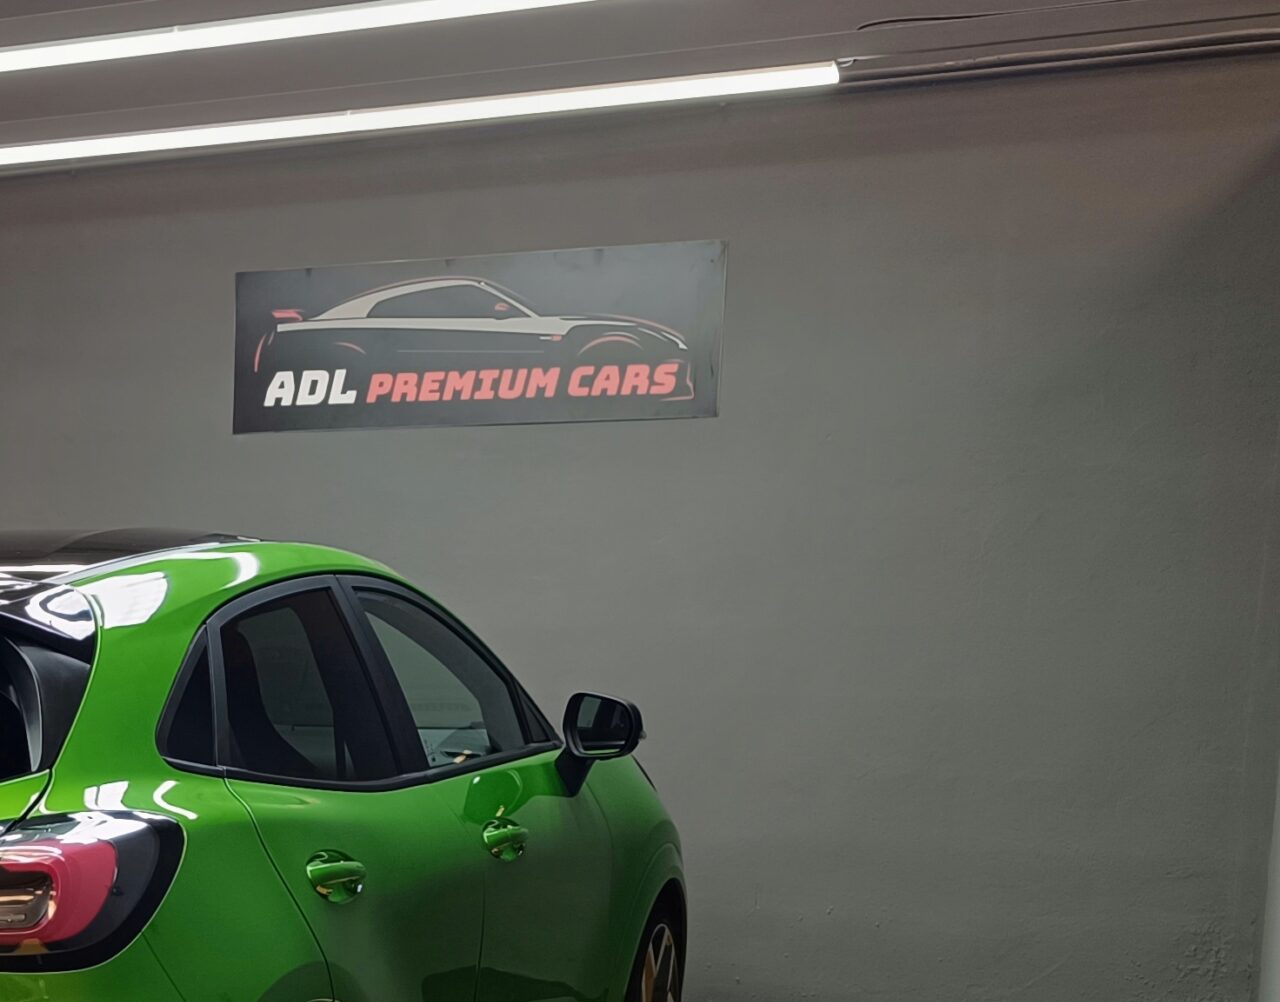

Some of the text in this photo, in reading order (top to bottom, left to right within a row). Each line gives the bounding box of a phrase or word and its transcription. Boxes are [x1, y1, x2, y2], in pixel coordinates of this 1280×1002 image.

[263, 362, 679, 407] ADL PREMIUM CARS
